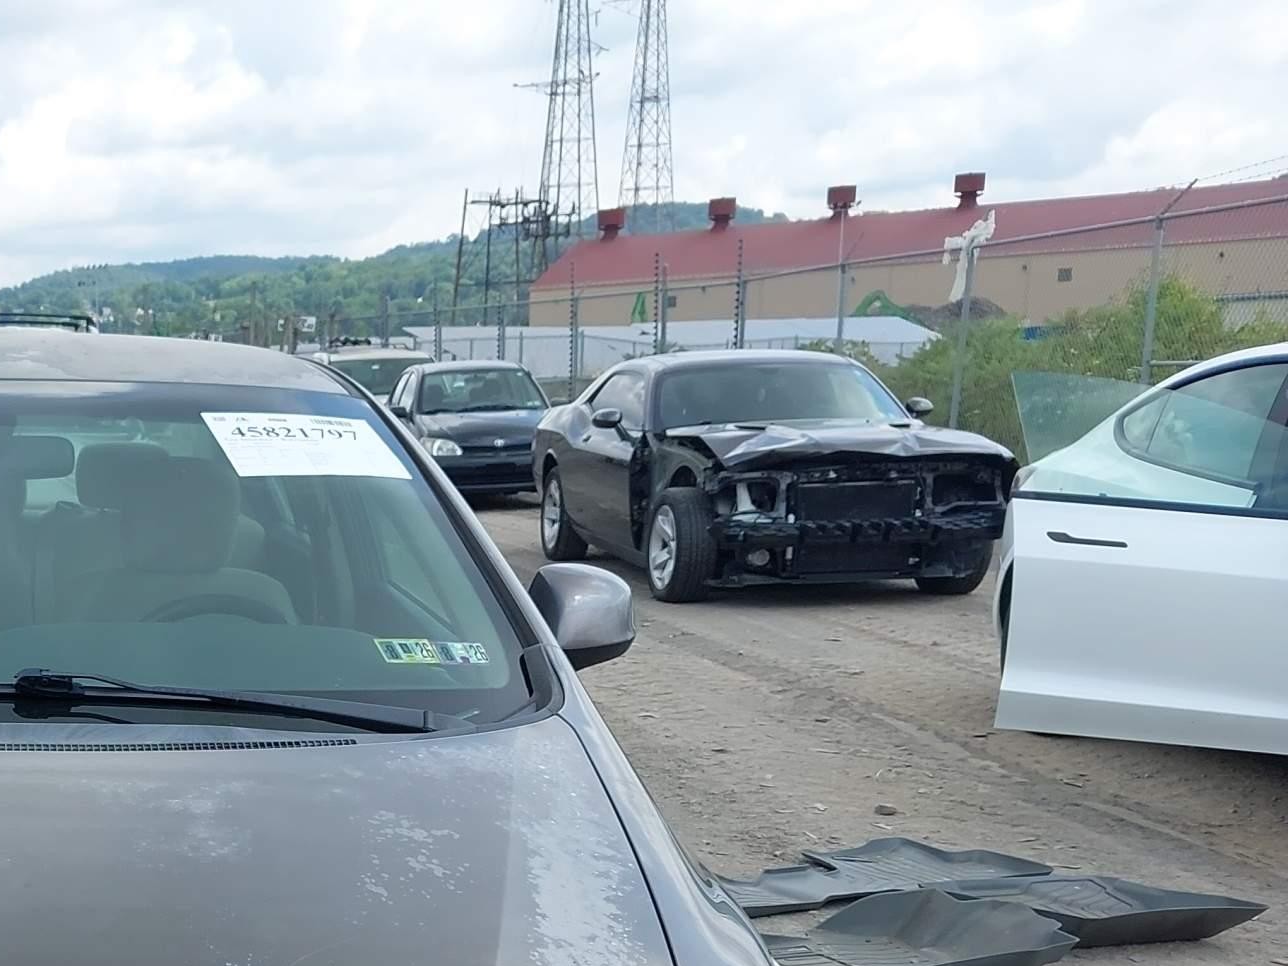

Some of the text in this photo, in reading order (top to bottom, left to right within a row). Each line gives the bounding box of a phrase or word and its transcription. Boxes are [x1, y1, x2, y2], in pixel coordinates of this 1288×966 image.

[231, 426, 357, 441] 45821797
[415, 642, 435, 659] 26
[469, 645, 489, 661] 26
